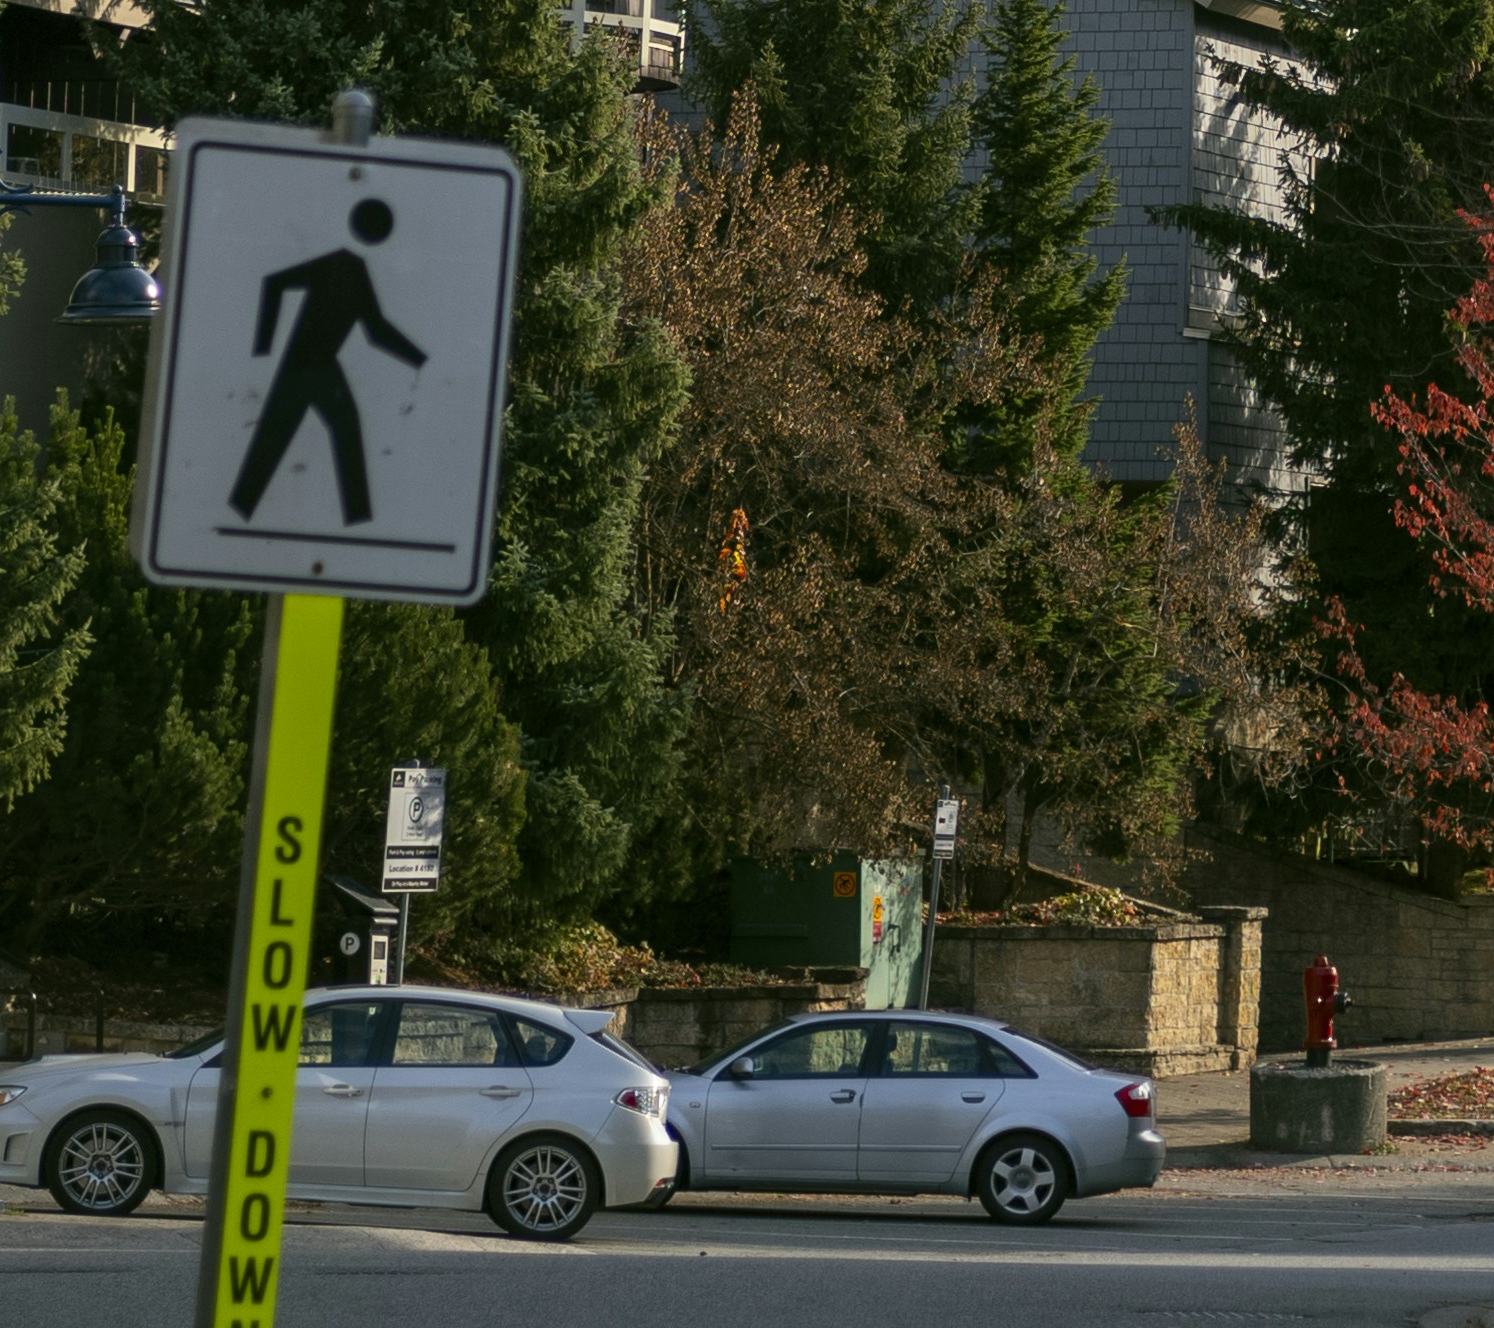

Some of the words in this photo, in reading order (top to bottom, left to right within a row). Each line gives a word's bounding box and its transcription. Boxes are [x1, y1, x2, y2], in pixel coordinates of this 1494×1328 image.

[389, 864, 414, 873] Location
[252, 815, 304, 1053] SLOW
[345, 936, 355, 951] P
